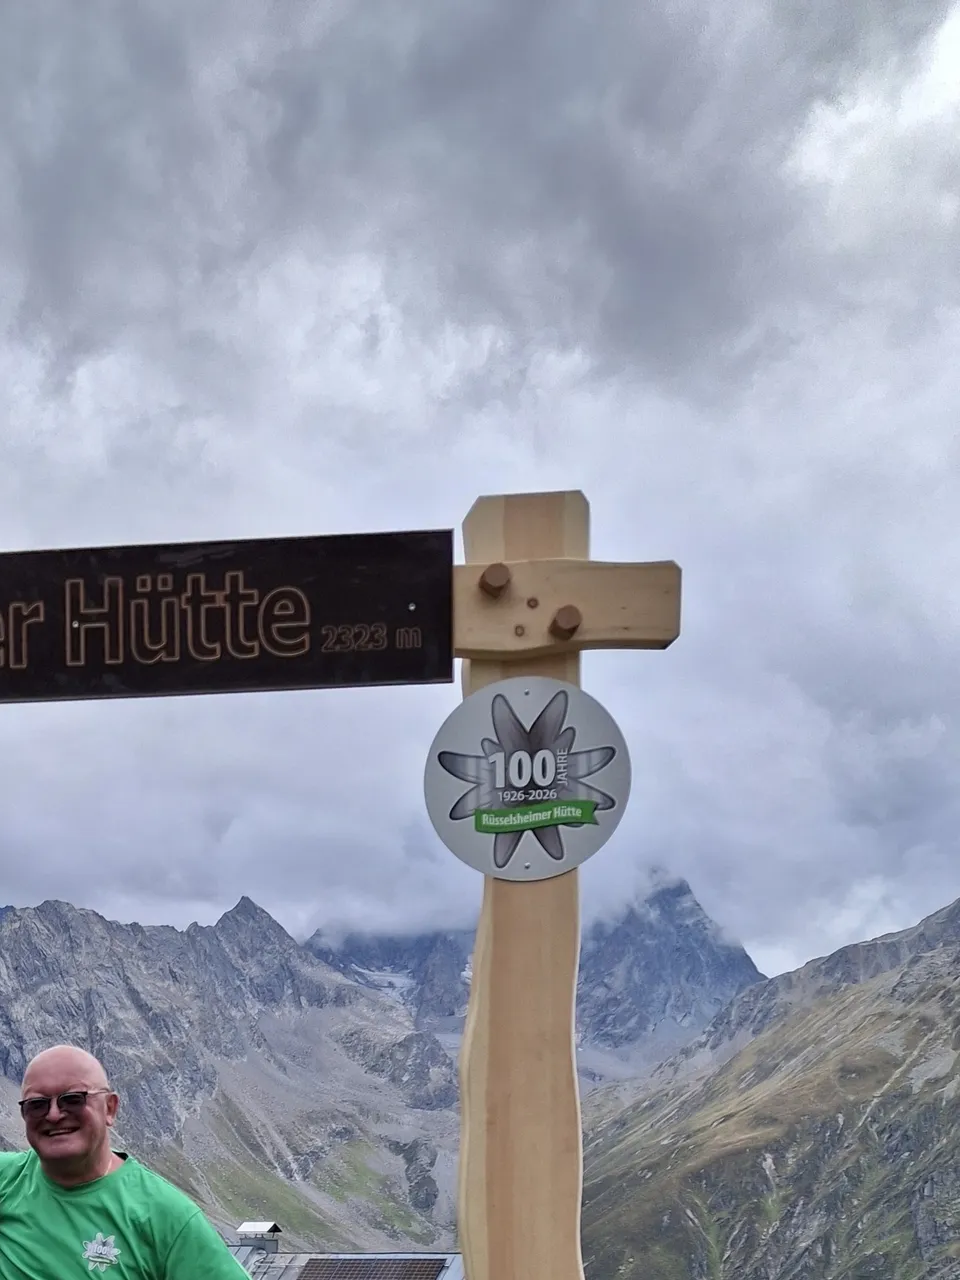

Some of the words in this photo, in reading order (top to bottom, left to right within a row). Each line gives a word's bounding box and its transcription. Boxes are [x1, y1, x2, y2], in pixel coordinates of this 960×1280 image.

[65, 570, 311, 666] Hütte
[320, 622, 387, 653] 2323
[395, 627, 422, 649] m
[488, 749, 556, 788] 100
[556, 748, 568, 786] JAHRE
[498, 789, 557, 802] 1926-2026
[482, 811, 552, 825] Rüsselsheimer
[553, 806, 582, 818] Hütte
